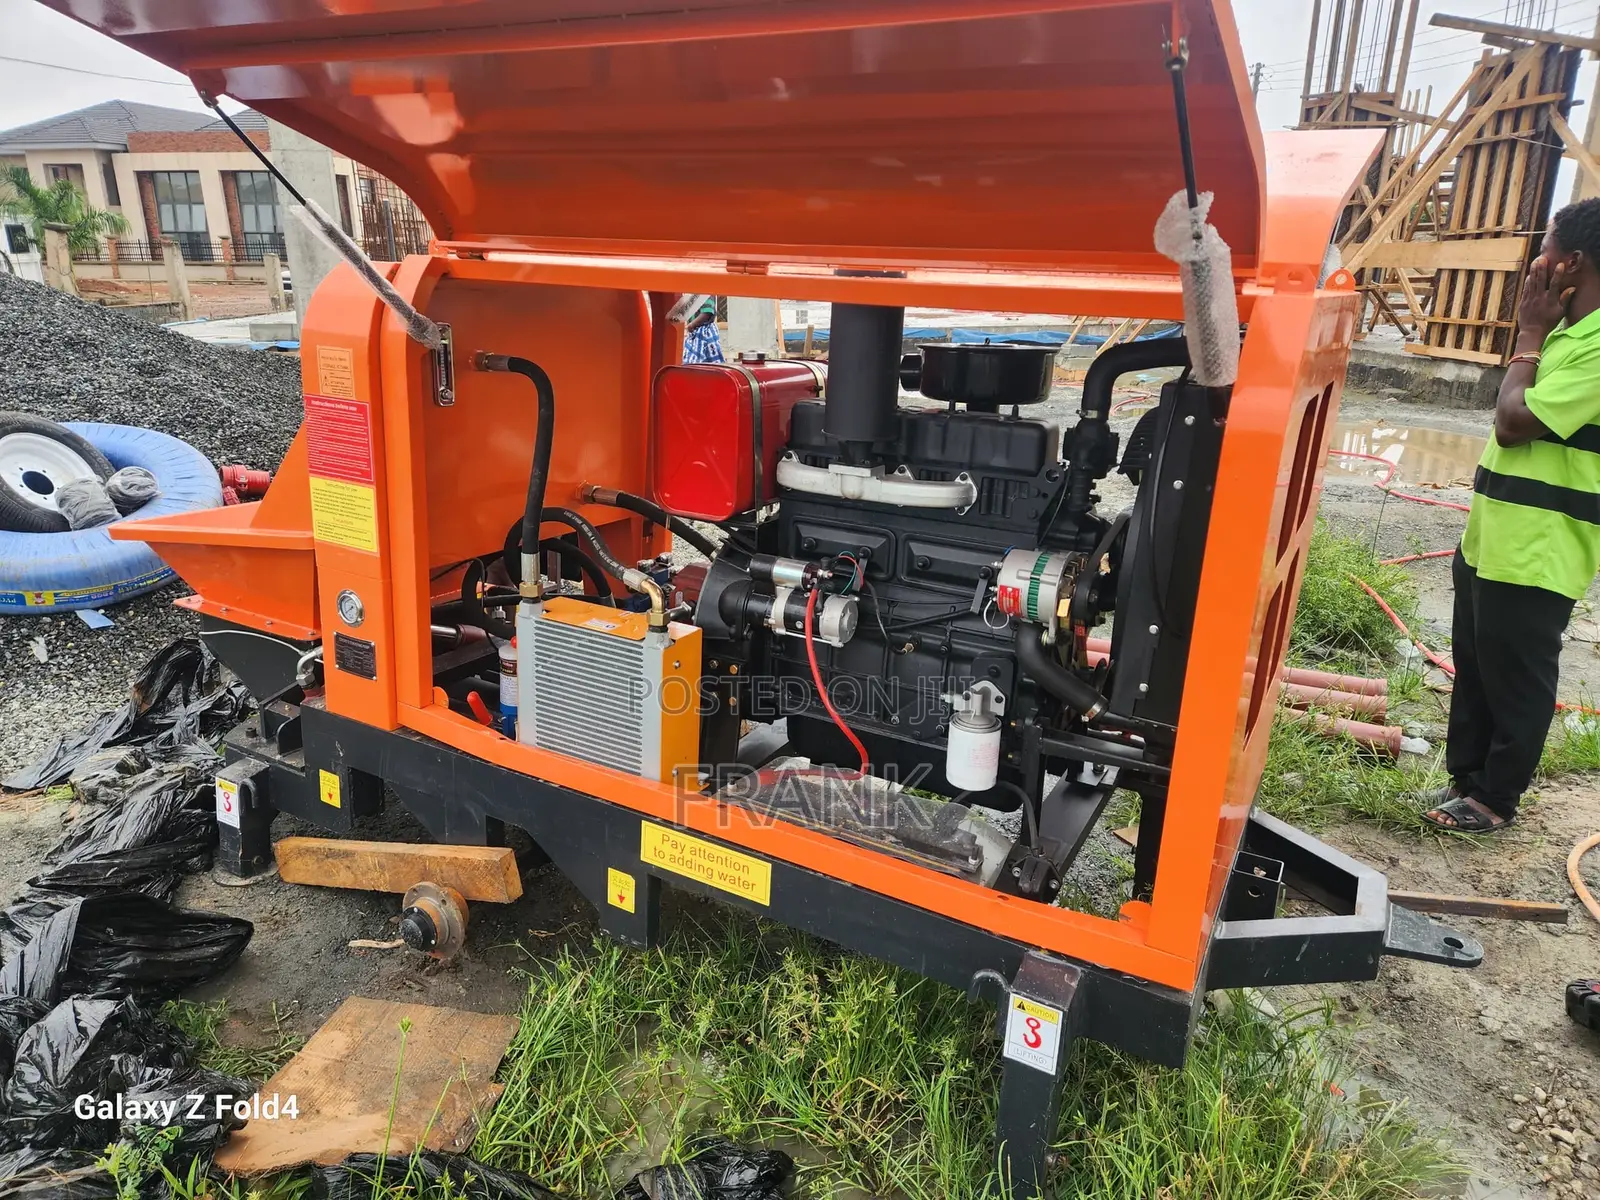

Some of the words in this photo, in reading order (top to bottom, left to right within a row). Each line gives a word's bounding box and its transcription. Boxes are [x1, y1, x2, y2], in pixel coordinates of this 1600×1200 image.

[653, 846, 666, 859] to
[669, 853, 714, 879] adding
[718, 868, 756, 892] water
[661, 833, 686, 854] Pay
[689, 844, 750, 875] attention
[1026, 1005, 1055, 1020] CAUTION
